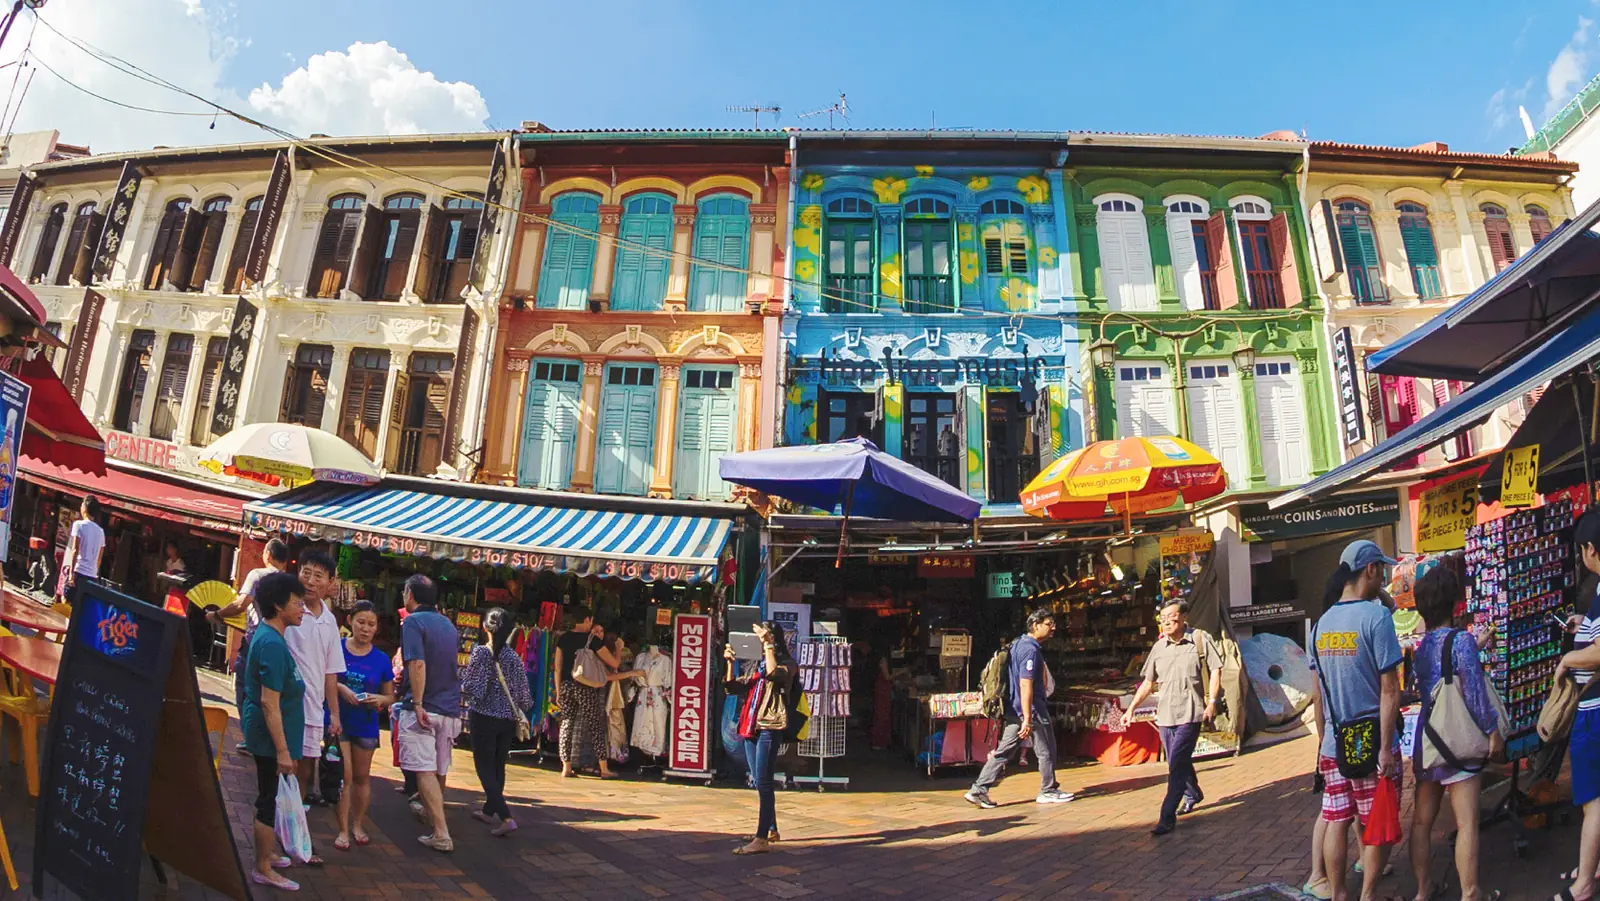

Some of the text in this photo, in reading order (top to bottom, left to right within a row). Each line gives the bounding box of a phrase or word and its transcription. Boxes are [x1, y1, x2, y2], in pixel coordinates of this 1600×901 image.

[254, 162, 288, 280] Chinatown Heritage Centre
[83, 295, 99, 340] Chinatown
[74, 340, 88, 376] Heritage
[450, 314, 476, 461] Chinatown Heritage Centre
[105, 432, 178, 470] CENTRE
[1504, 453, 1513, 490] 3
[1514, 463, 1523, 477] FOR
[1528, 448, 1538, 488] 5
[255, 513, 263, 526] 3
[265, 516, 282, 530] for
[1244, 514, 1283, 524] SINGAPORE
[1284, 510, 1322, 524] COINS
[1322, 510, 1338, 518] AND
[1338, 502, 1374, 517] NOTES
[1419, 488, 1476, 530] 2 FOR $ 5
[355, 532, 363, 544] 3
[366, 534, 385, 548] for
[1173, 535, 1201, 545] MERRY
[1418, 527, 1432, 542] ONE
[1433, 522, 1452, 539] PIECE
[472, 549, 481, 561] 3
[485, 551, 507, 564] for
[605, 563, 615, 575] 3
[620, 564, 643, 577] for
[1252, 608, 1278, 616] LARGEST
[98, 613, 139, 648] Tiger
[678, 624, 704, 763] MONEY CHANGER
